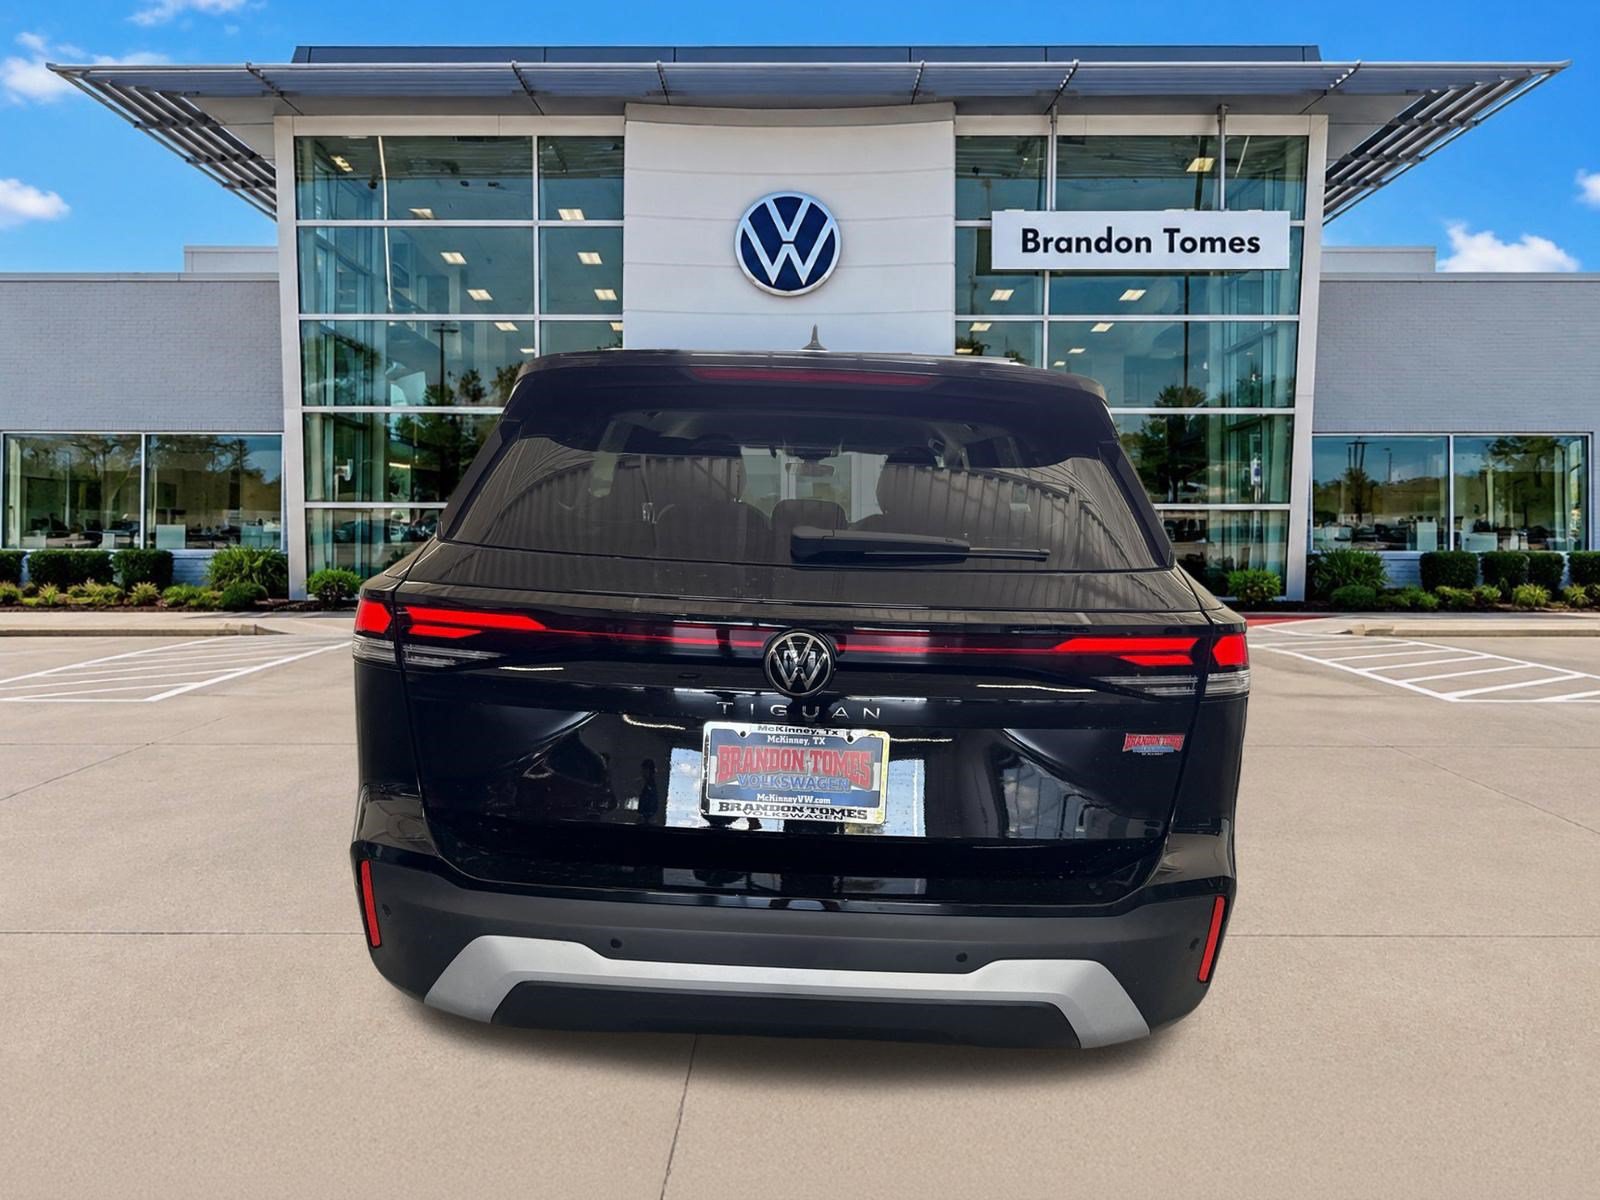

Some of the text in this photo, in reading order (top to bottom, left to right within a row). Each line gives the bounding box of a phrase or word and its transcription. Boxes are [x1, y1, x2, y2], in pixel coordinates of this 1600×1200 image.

[1021, 226, 1261, 254] Brandon Tomes
[716, 701, 881, 719] TIGUAN
[757, 724, 820, 735] McKinney,
[767, 735, 826, 746] McKinney, TX
[717, 745, 872, 790] BRANDON TOMES
[738, 773, 850, 793] VOLKSWAGEN
[756, 793, 831, 805] McKinneyVW.com
[718, 801, 868, 820] BRANDON TOMES
[744, 810, 844, 821] VOLKSWAGEN
